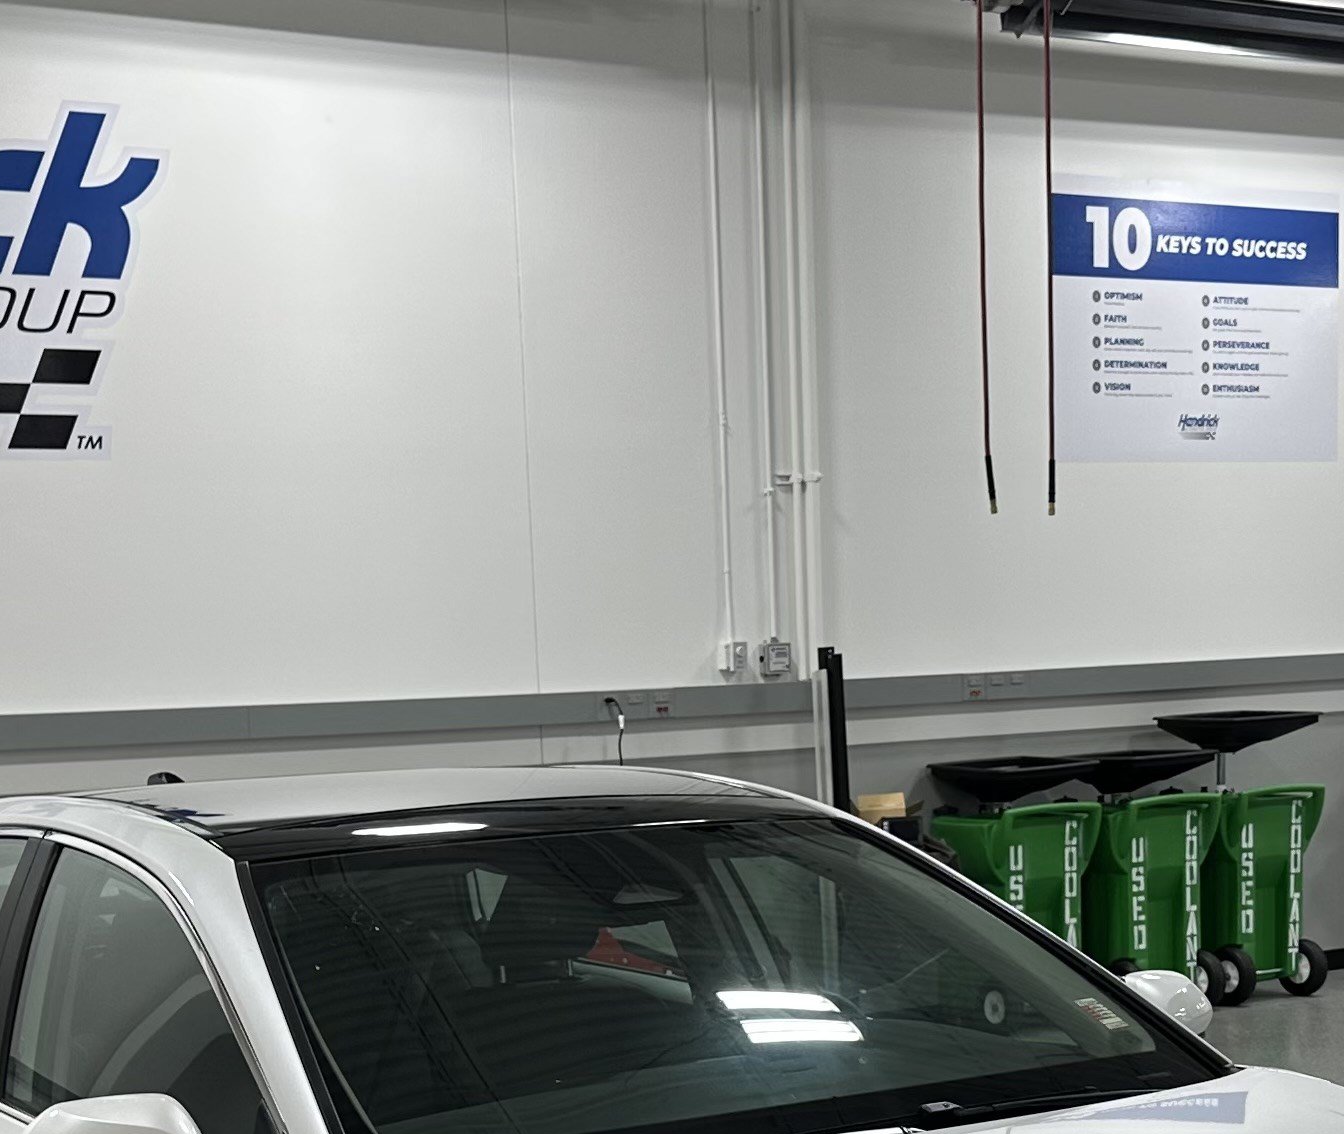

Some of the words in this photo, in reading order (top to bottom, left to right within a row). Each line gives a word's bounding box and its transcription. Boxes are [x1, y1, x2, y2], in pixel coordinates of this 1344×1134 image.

[1086, 205, 1152, 271] 10
[1156, 234, 1201, 254] KEYS
[1206, 237, 1229, 256] TO
[1231, 239, 1307, 260] SUCCESS
[1104, 291, 1143, 300] OPTIMISM
[1213, 296, 1248, 305] ATTITUDE
[1104, 314, 1127, 323] FAITH
[1104, 337, 1144, 346] PLANNING
[1213, 340, 1270, 349] PERSEVERANCE
[1104, 360, 1167, 369] DETERMINATION
[1213, 362, 1259, 371] KNOWLEDGE
[1104, 382, 1131, 391] VISION
[1213, 384, 1259, 393] ENTHUSIASM
[77, 435, 103, 450] TM
[1241, 823, 1254, 934] USED
[1287, 799, 1303, 972] COOLANT
[1131, 836, 1147, 950] USED
